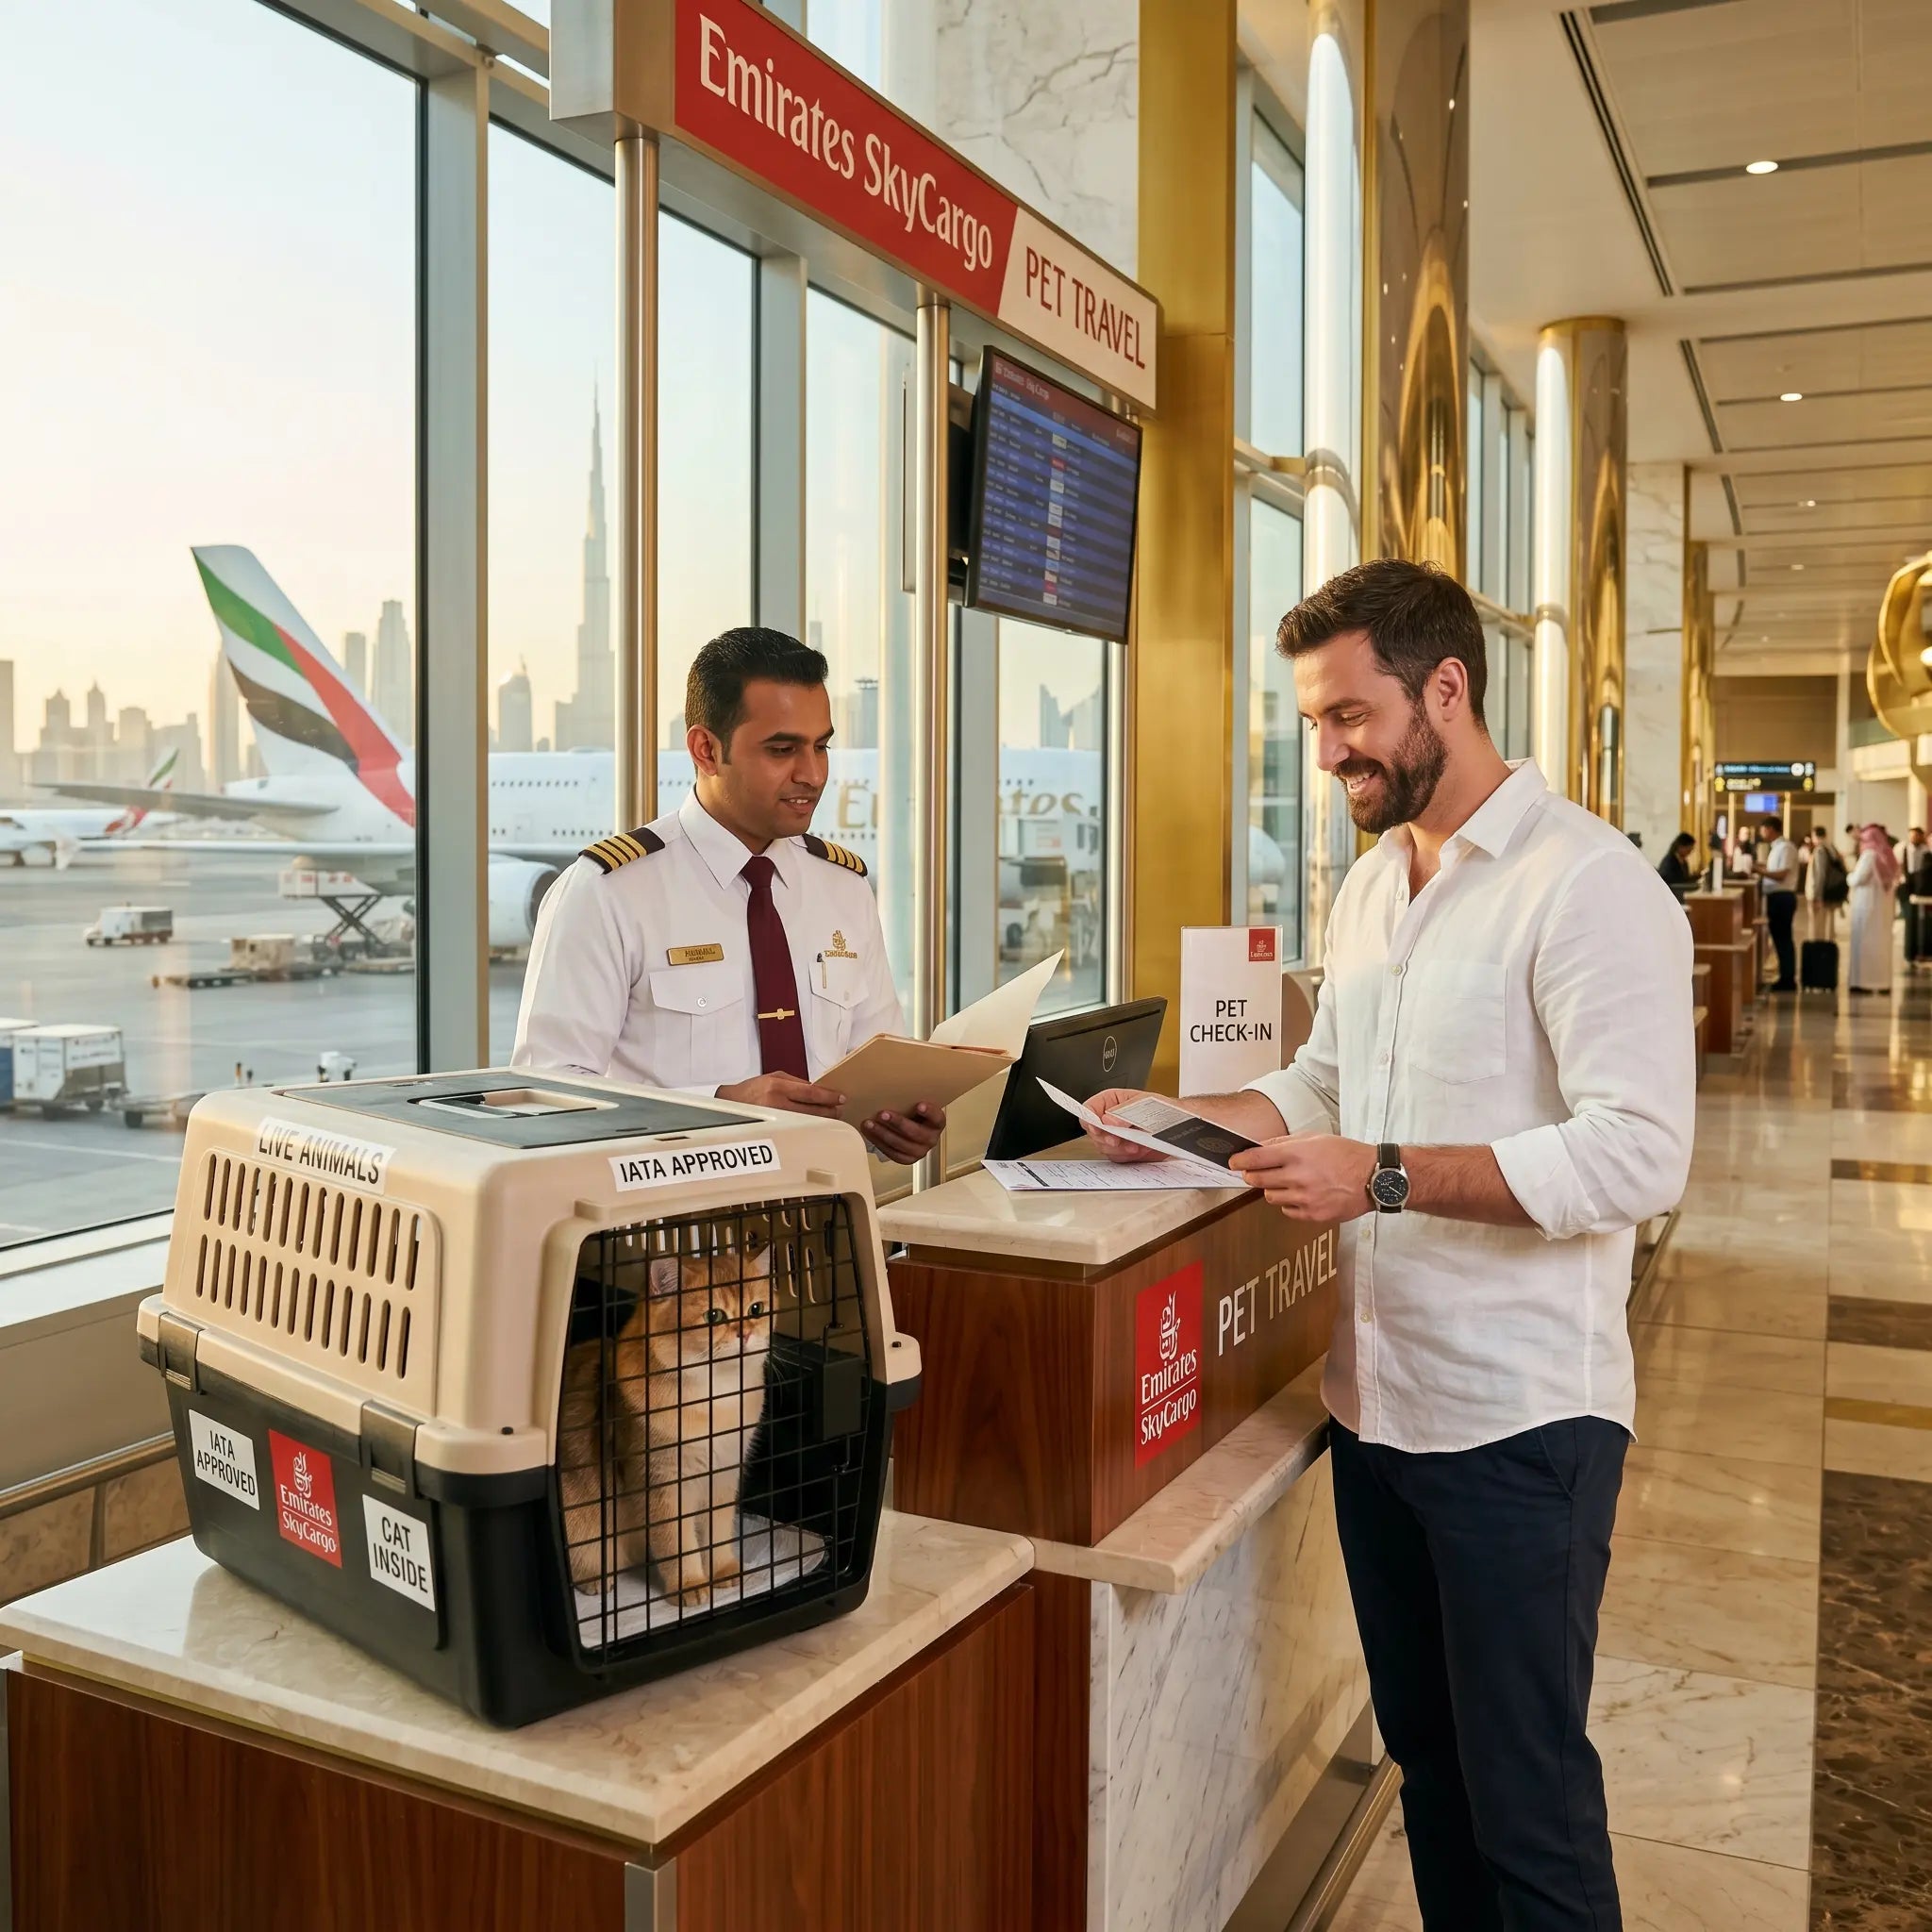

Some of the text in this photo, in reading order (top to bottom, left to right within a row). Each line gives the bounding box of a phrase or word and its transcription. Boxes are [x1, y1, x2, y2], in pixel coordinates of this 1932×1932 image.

[699, 12, 993, 272] Emirates SkyCargo
[1025, 246, 1146, 371] PET TRAVEL
[1215, 999, 1248, 1018] PET
[1190, 1023, 1273, 1042] CHECK-IN
[258, 1124, 384, 1185] LIVE ANIMALS
[620, 1144, 773, 1183] IATA APPROVED
[1218, 1228, 1338, 1357] PET TRAVEL
[1141, 1348, 1197, 1406] Emirates
[1141, 1388, 1197, 1445] SkyCargo
[209, 1429, 236, 1461] IATA
[196, 1449, 256, 1496] APPROVED
[279, 1483, 333, 1527] Emirates
[282, 1511, 338, 1554] SkyCargo
[381, 1515, 411, 1553] CAT
[373, 1542, 428, 1593] INSIDE
